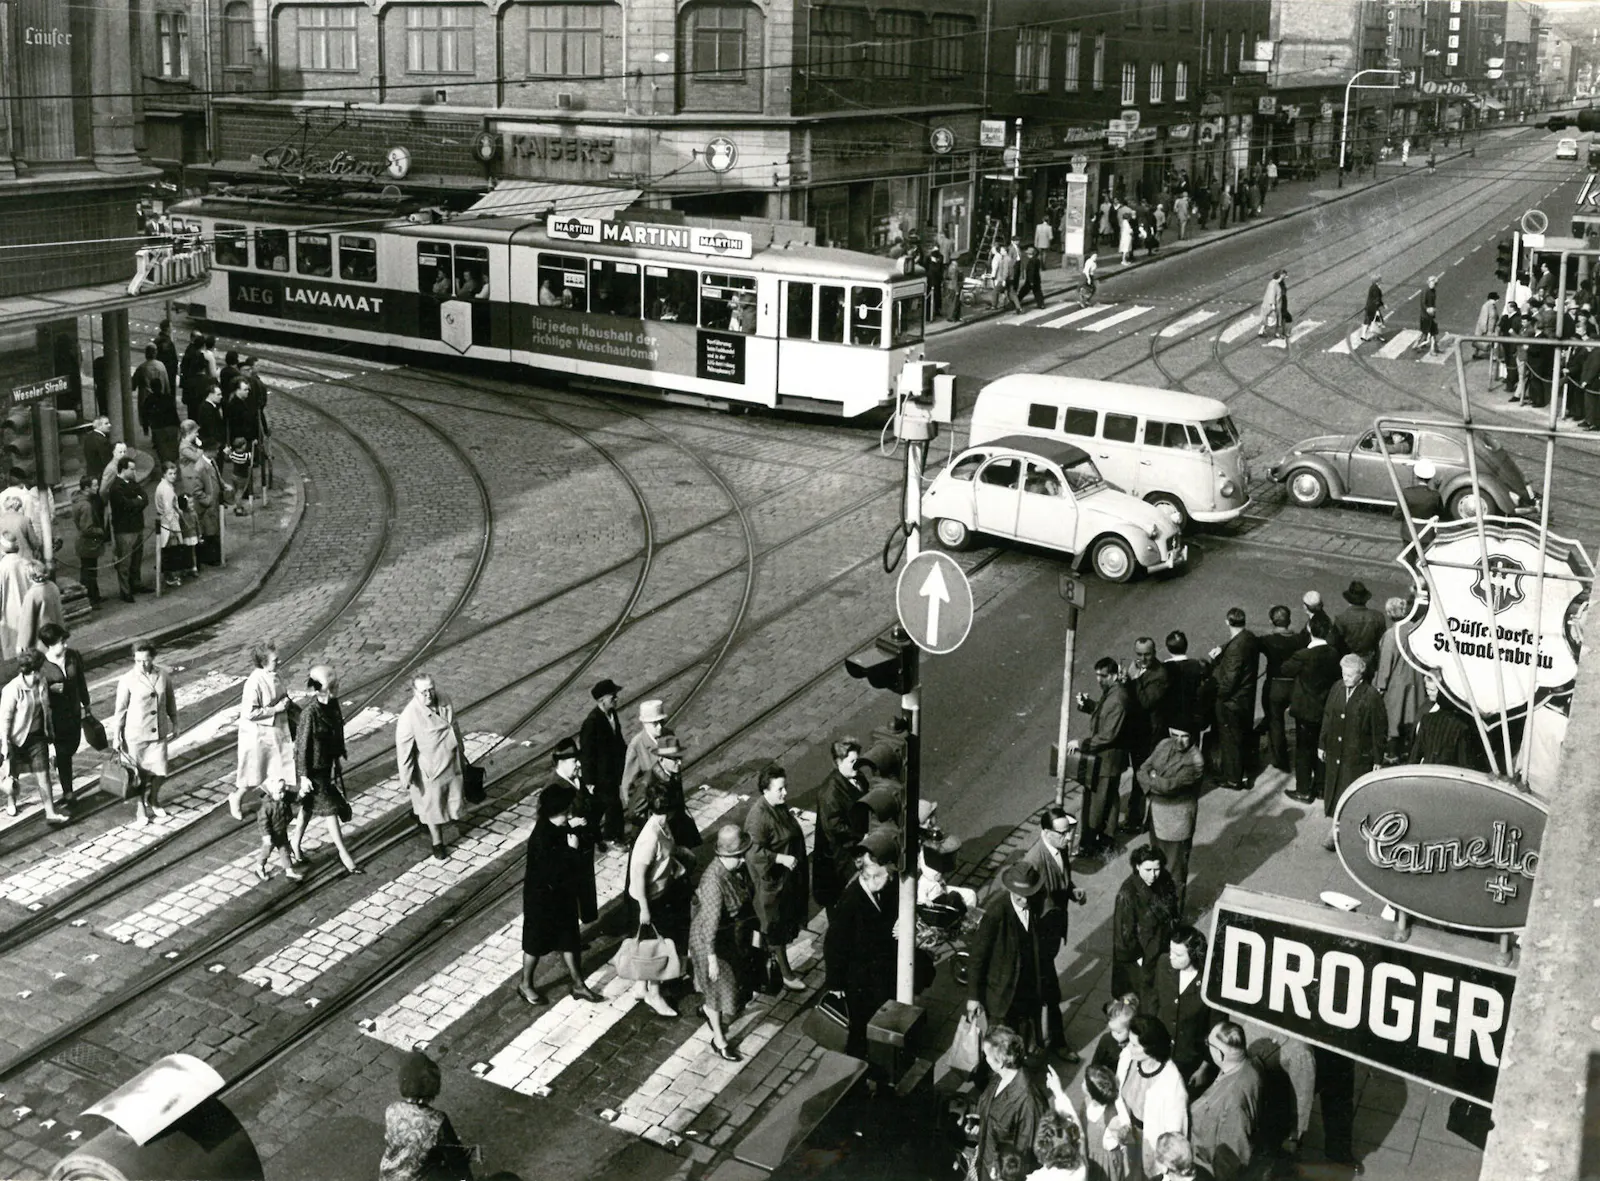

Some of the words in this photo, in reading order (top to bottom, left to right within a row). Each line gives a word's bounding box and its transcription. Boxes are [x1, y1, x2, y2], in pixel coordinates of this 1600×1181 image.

[25, 26, 72, 48] Läufer
[555, 221, 593, 235] MARTINI
[603, 223, 688, 248] MARTINI
[700, 236, 742, 250] MARTINI
[237, 285, 273, 304] AEG
[285, 286, 383, 313] LAVAMAT
[548, 319, 579, 335] jeden
[581, 323, 633, 343] Haushalt
[532, 332, 572, 349] richtige
[576, 338, 658, 361] Waschautomat
[13, 385, 44, 402] Weseler
[44, 379, 68, 394] Straße
[1220, 925, 1505, 1067] DROGER
